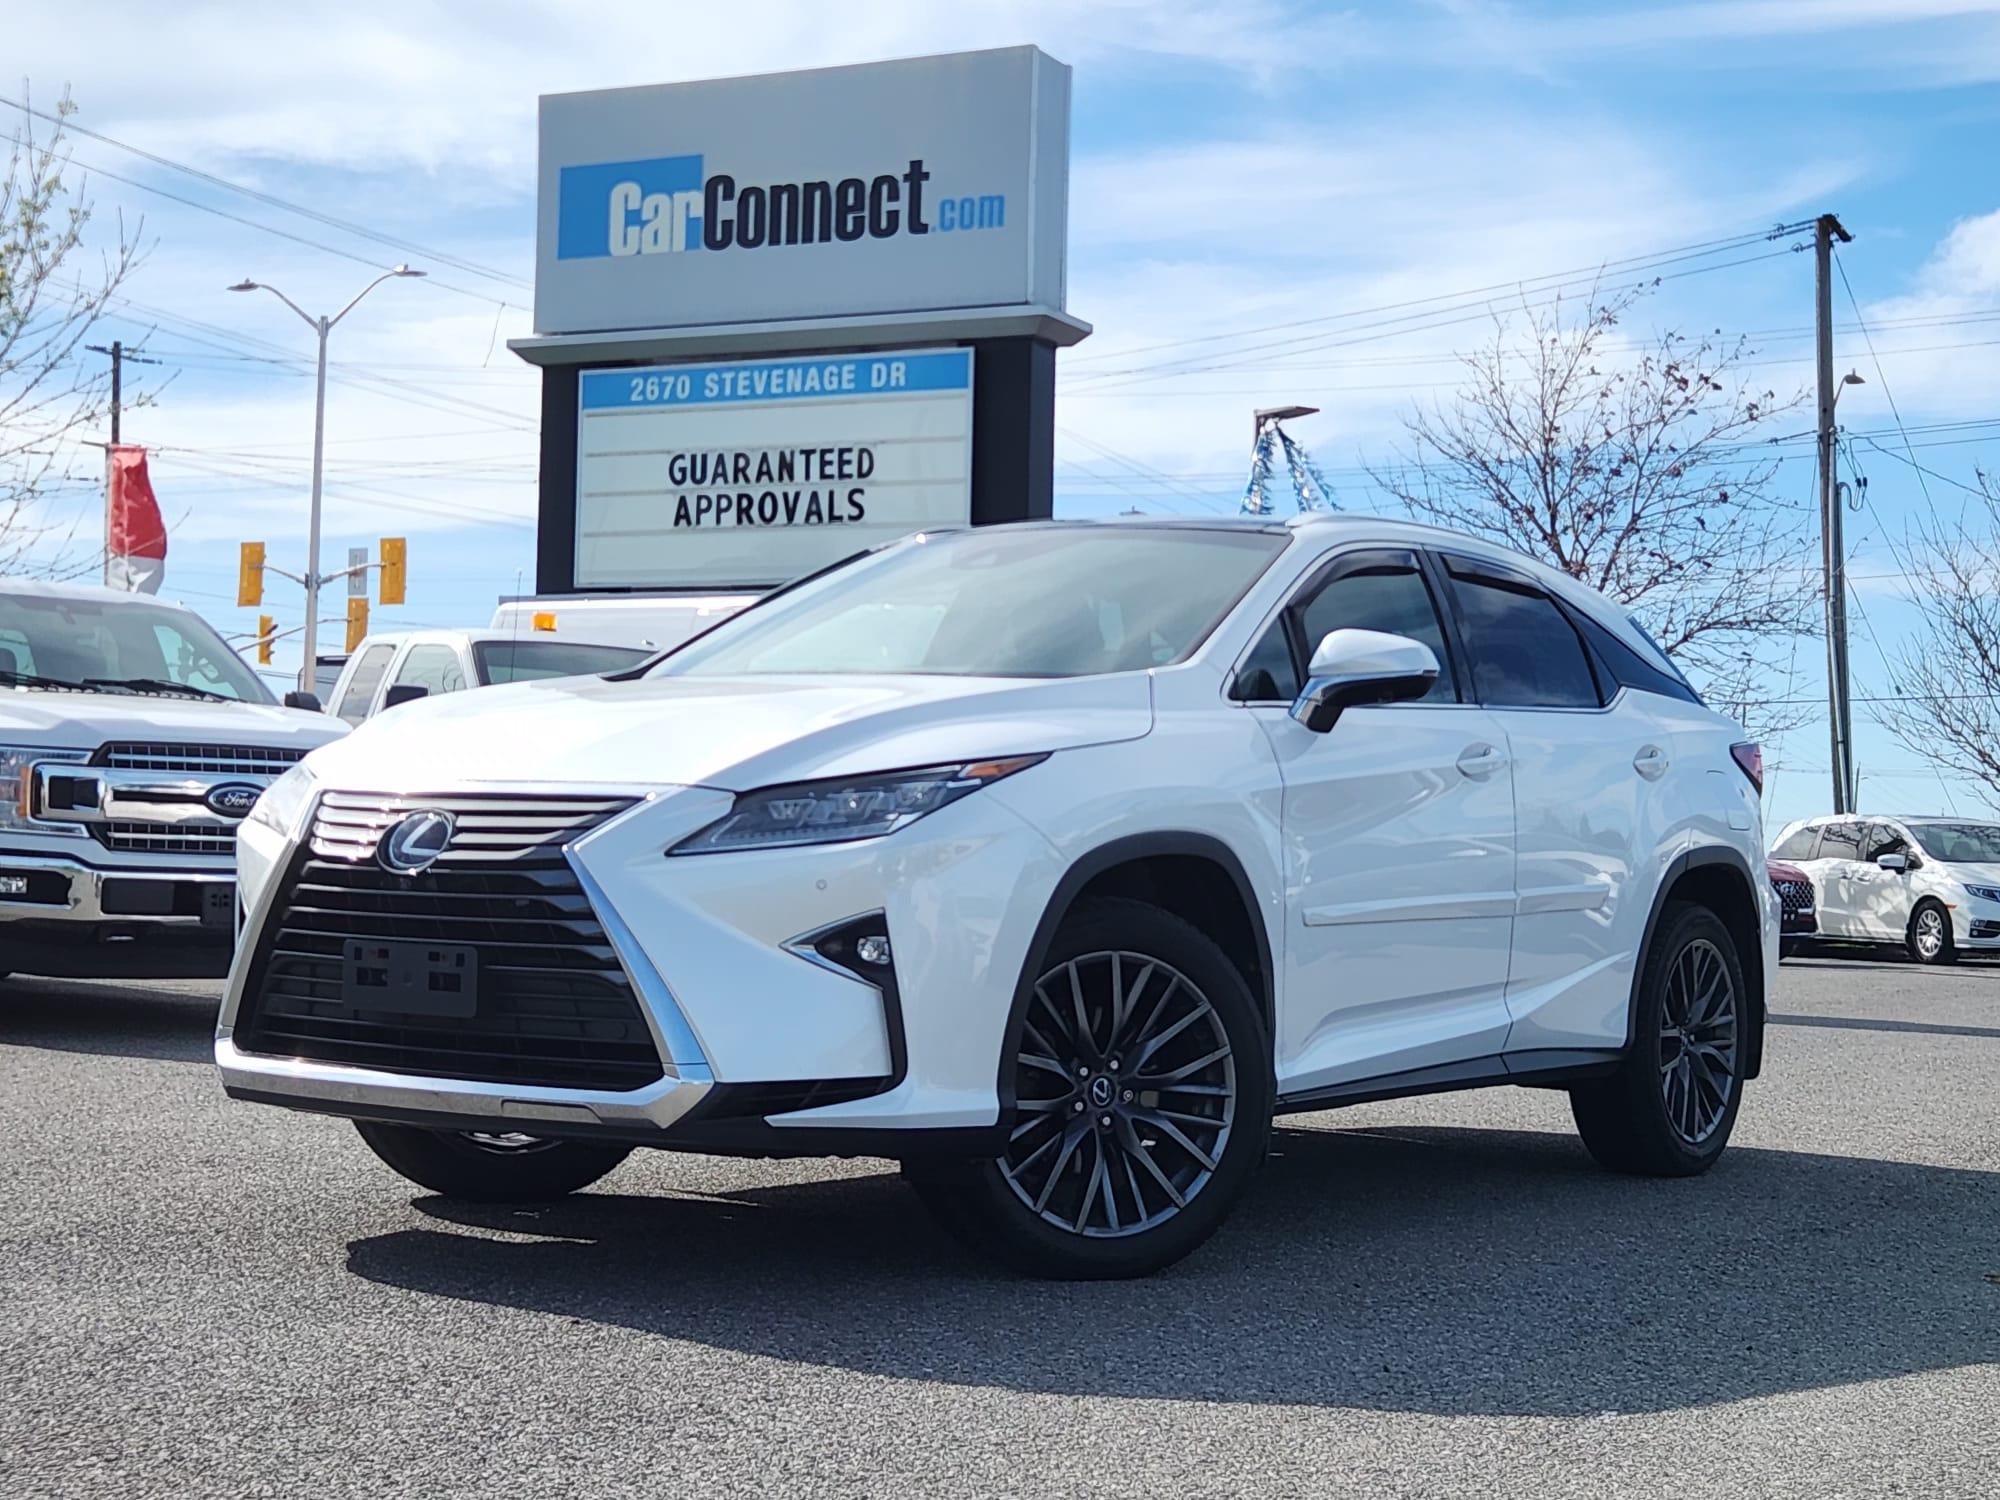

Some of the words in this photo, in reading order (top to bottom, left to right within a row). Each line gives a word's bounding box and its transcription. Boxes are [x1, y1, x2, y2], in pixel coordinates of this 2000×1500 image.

[630, 375, 691, 401] 2670
[704, 364, 856, 398] STEVENAGE
[871, 362, 906, 388] DR
[668, 447, 875, 486] GUARANTEED
[673, 488, 866, 528] APPROVALS
[223, 791, 257, 807] Ford
